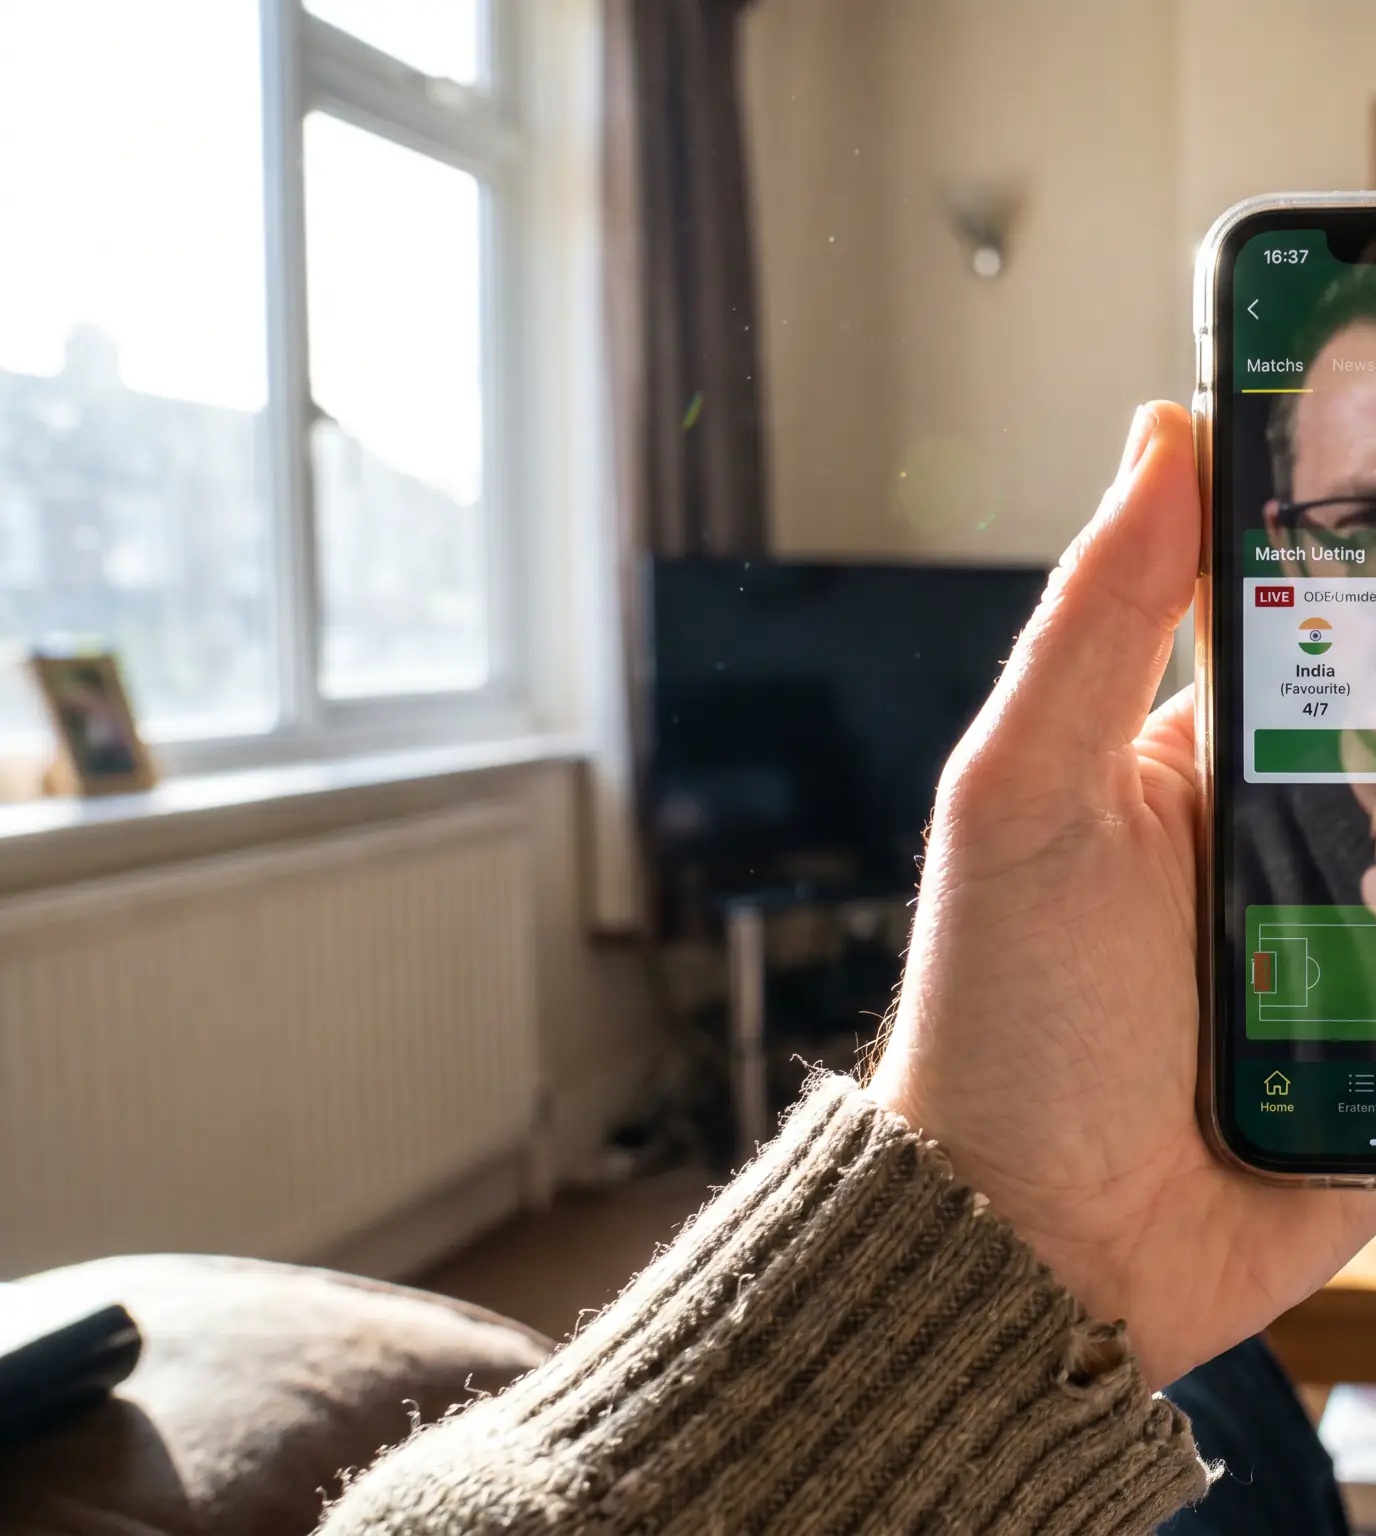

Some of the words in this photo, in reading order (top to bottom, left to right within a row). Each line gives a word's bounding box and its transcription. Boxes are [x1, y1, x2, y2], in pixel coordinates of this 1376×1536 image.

[1263, 250, 1308, 265] 16:37
[1247, 358, 1303, 372] Matchs
[1332, 358, 1375, 372] News
[1255, 547, 1306, 562] Match
[1311, 547, 1366, 565] Ueting
[1260, 592, 1289, 603] LIVE
[1296, 664, 1335, 677] India
[1280, 683, 1351, 697] (Favourite)
[1302, 702, 1328, 717] 4/7
[1261, 1102, 1294, 1113] Home
